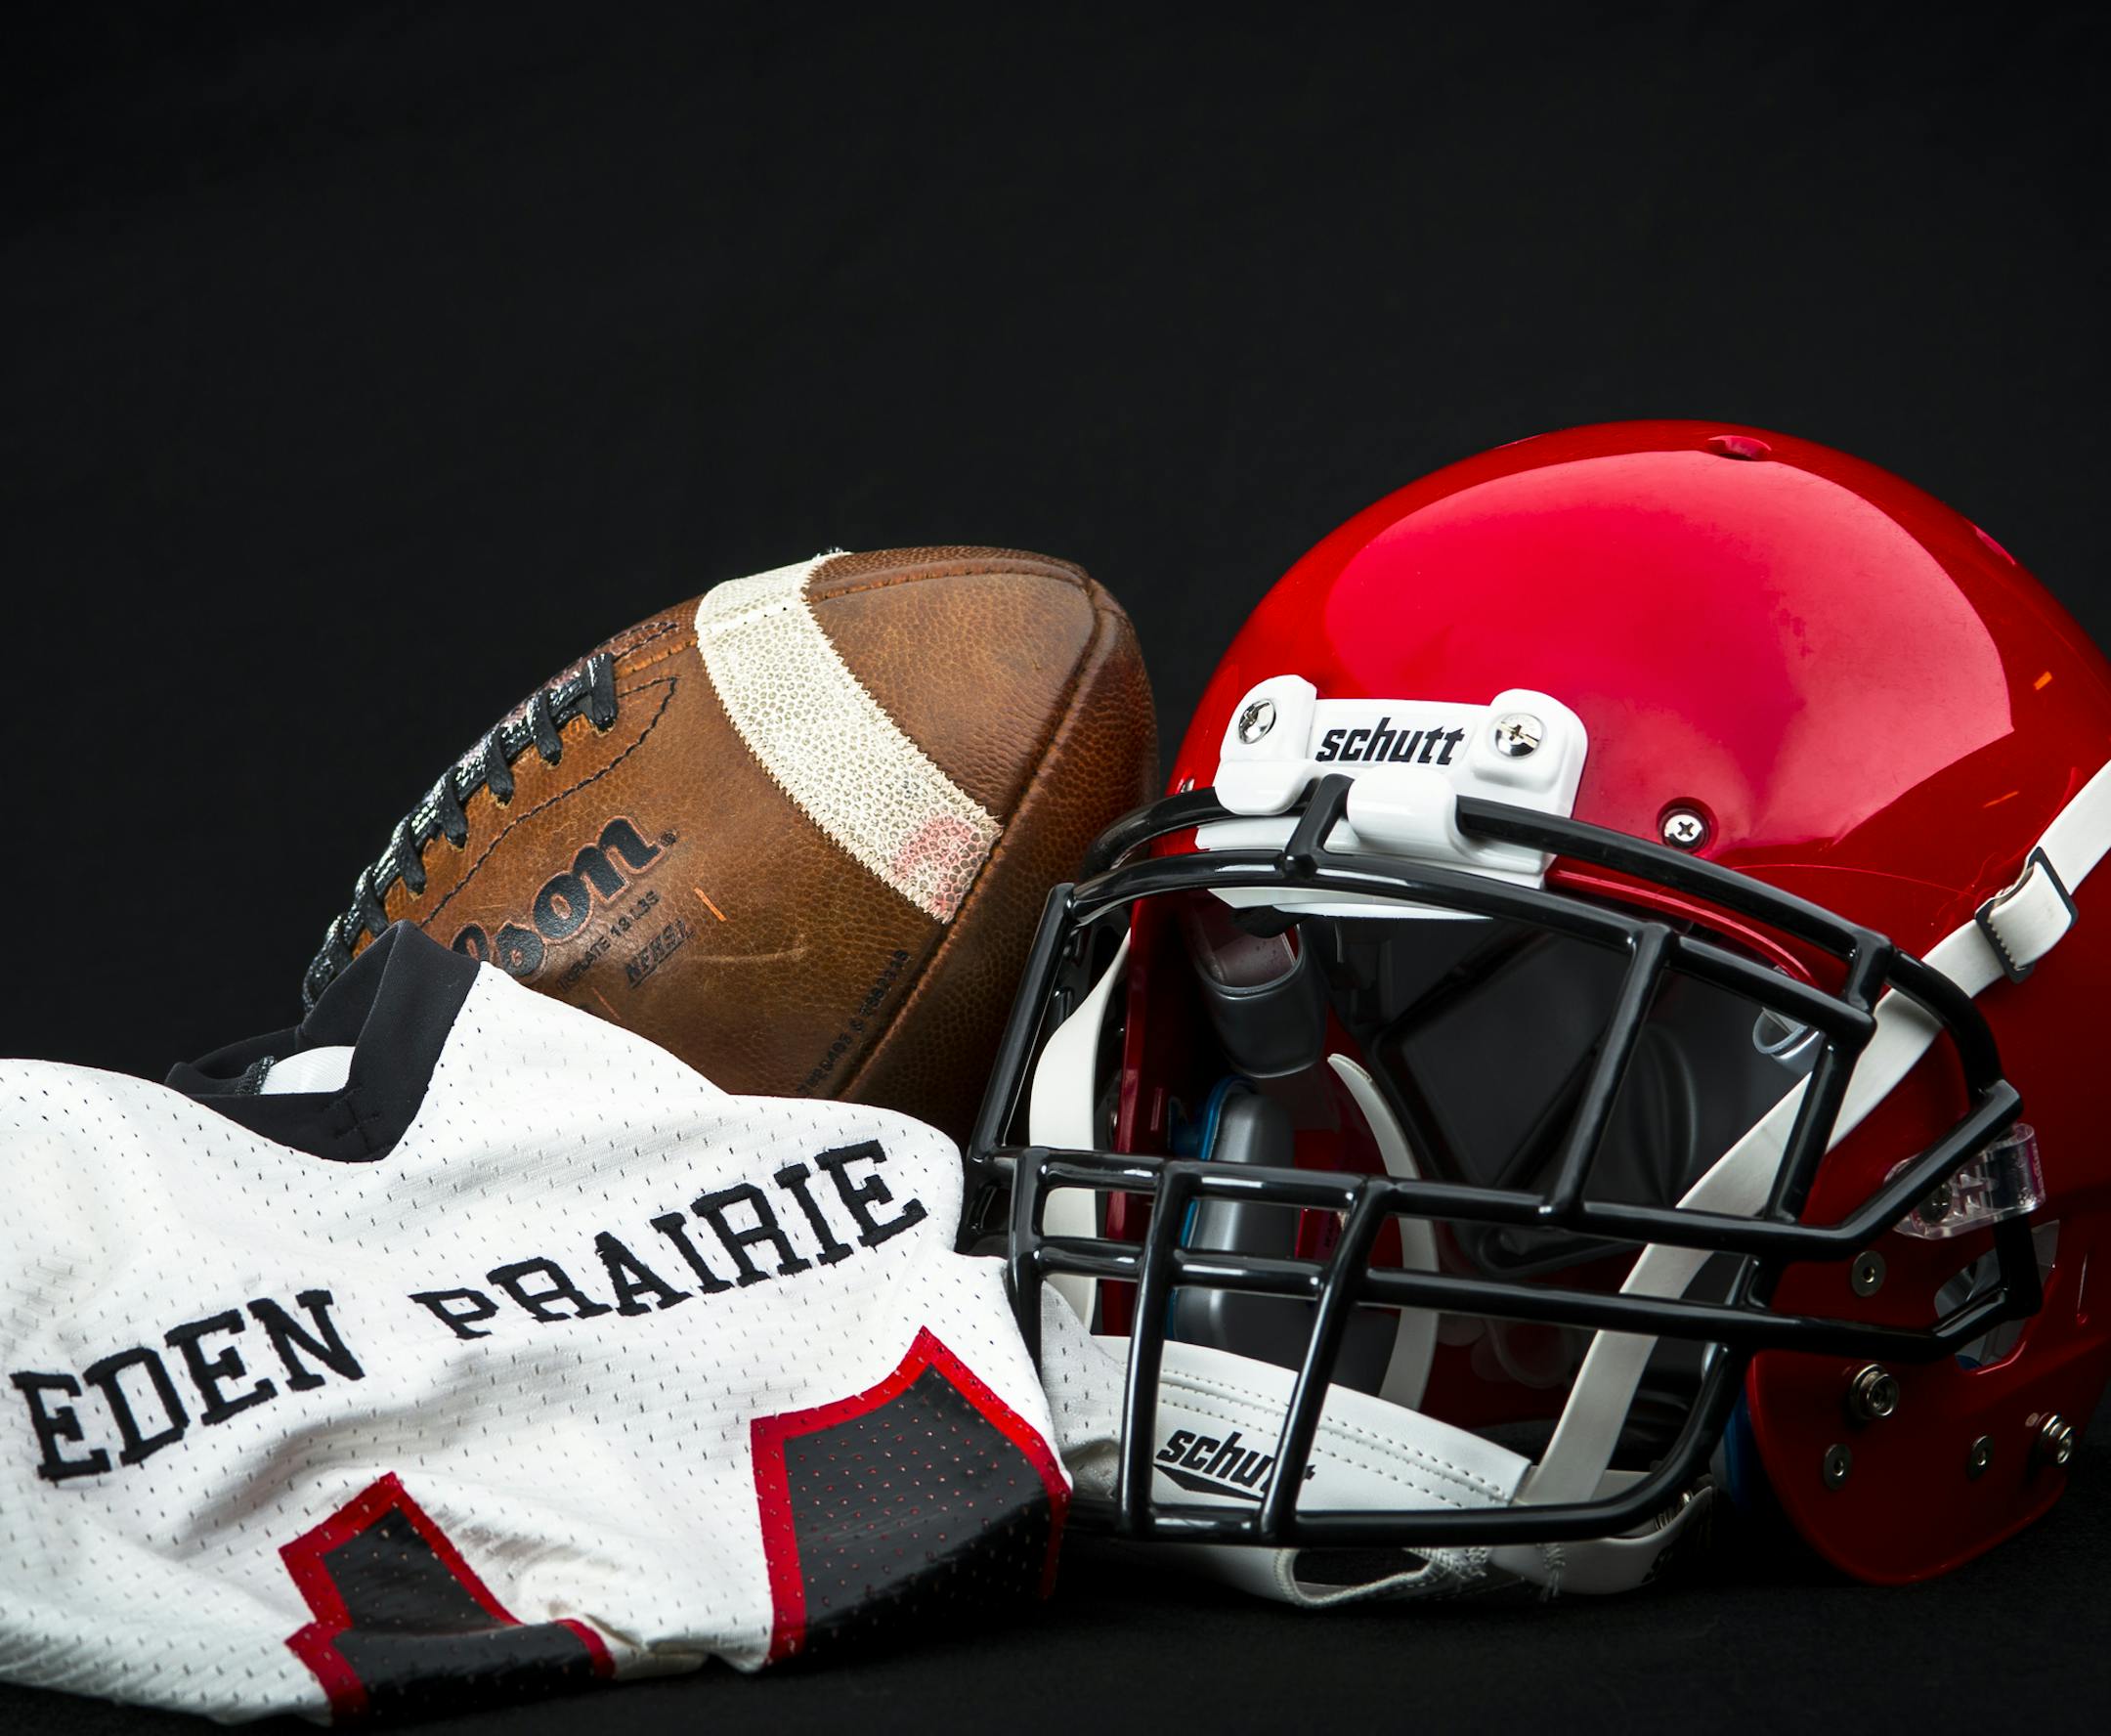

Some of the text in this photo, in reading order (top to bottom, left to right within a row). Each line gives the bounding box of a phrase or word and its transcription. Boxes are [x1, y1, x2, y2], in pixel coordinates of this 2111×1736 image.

[1314, 716, 1465, 766] schutt
[9, 1139, 928, 1480] EDEN PRAIRIE
[1155, 1429, 1316, 1493] schu
